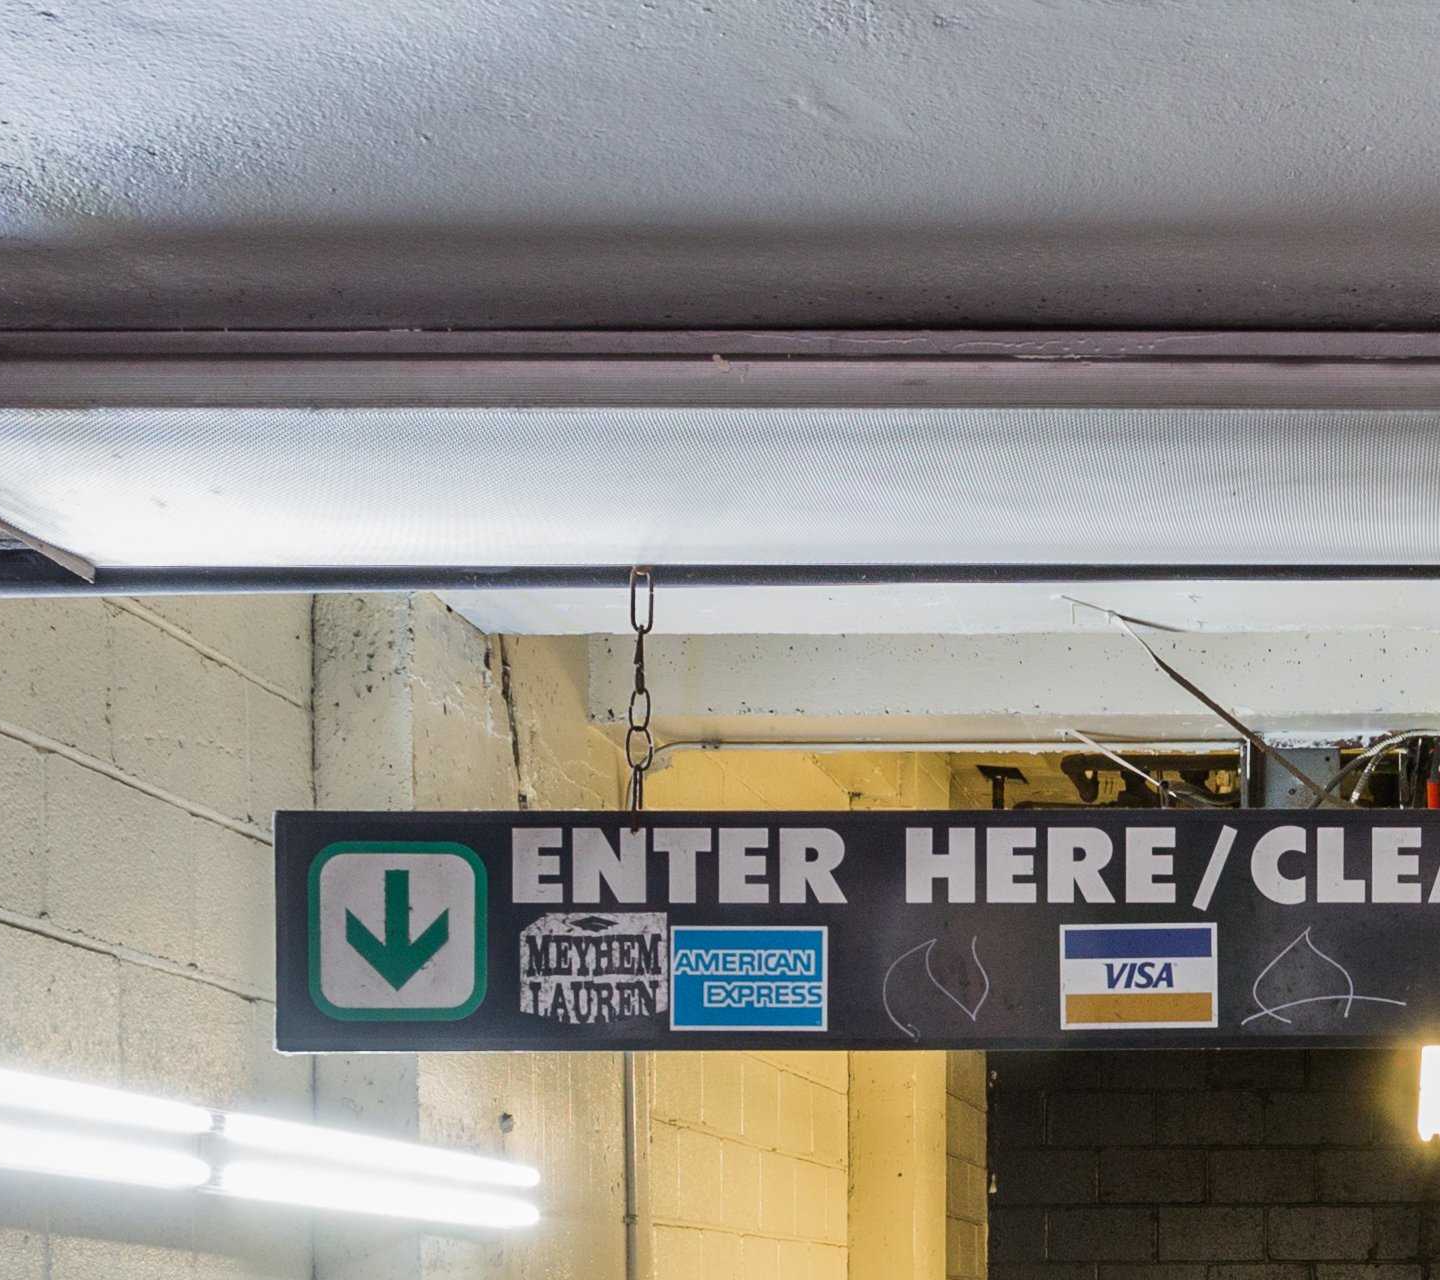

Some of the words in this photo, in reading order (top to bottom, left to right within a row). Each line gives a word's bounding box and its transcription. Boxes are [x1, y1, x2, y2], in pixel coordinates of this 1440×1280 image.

[512, 827, 846, 905] ENTER
[526, 933, 662, 977] MEYHEM
[674, 951, 813, 974] AMERICAN
[1103, 962, 1174, 989] VISA
[528, 981, 659, 1024] LAUREN
[706, 983, 823, 1006] EXPRESS
